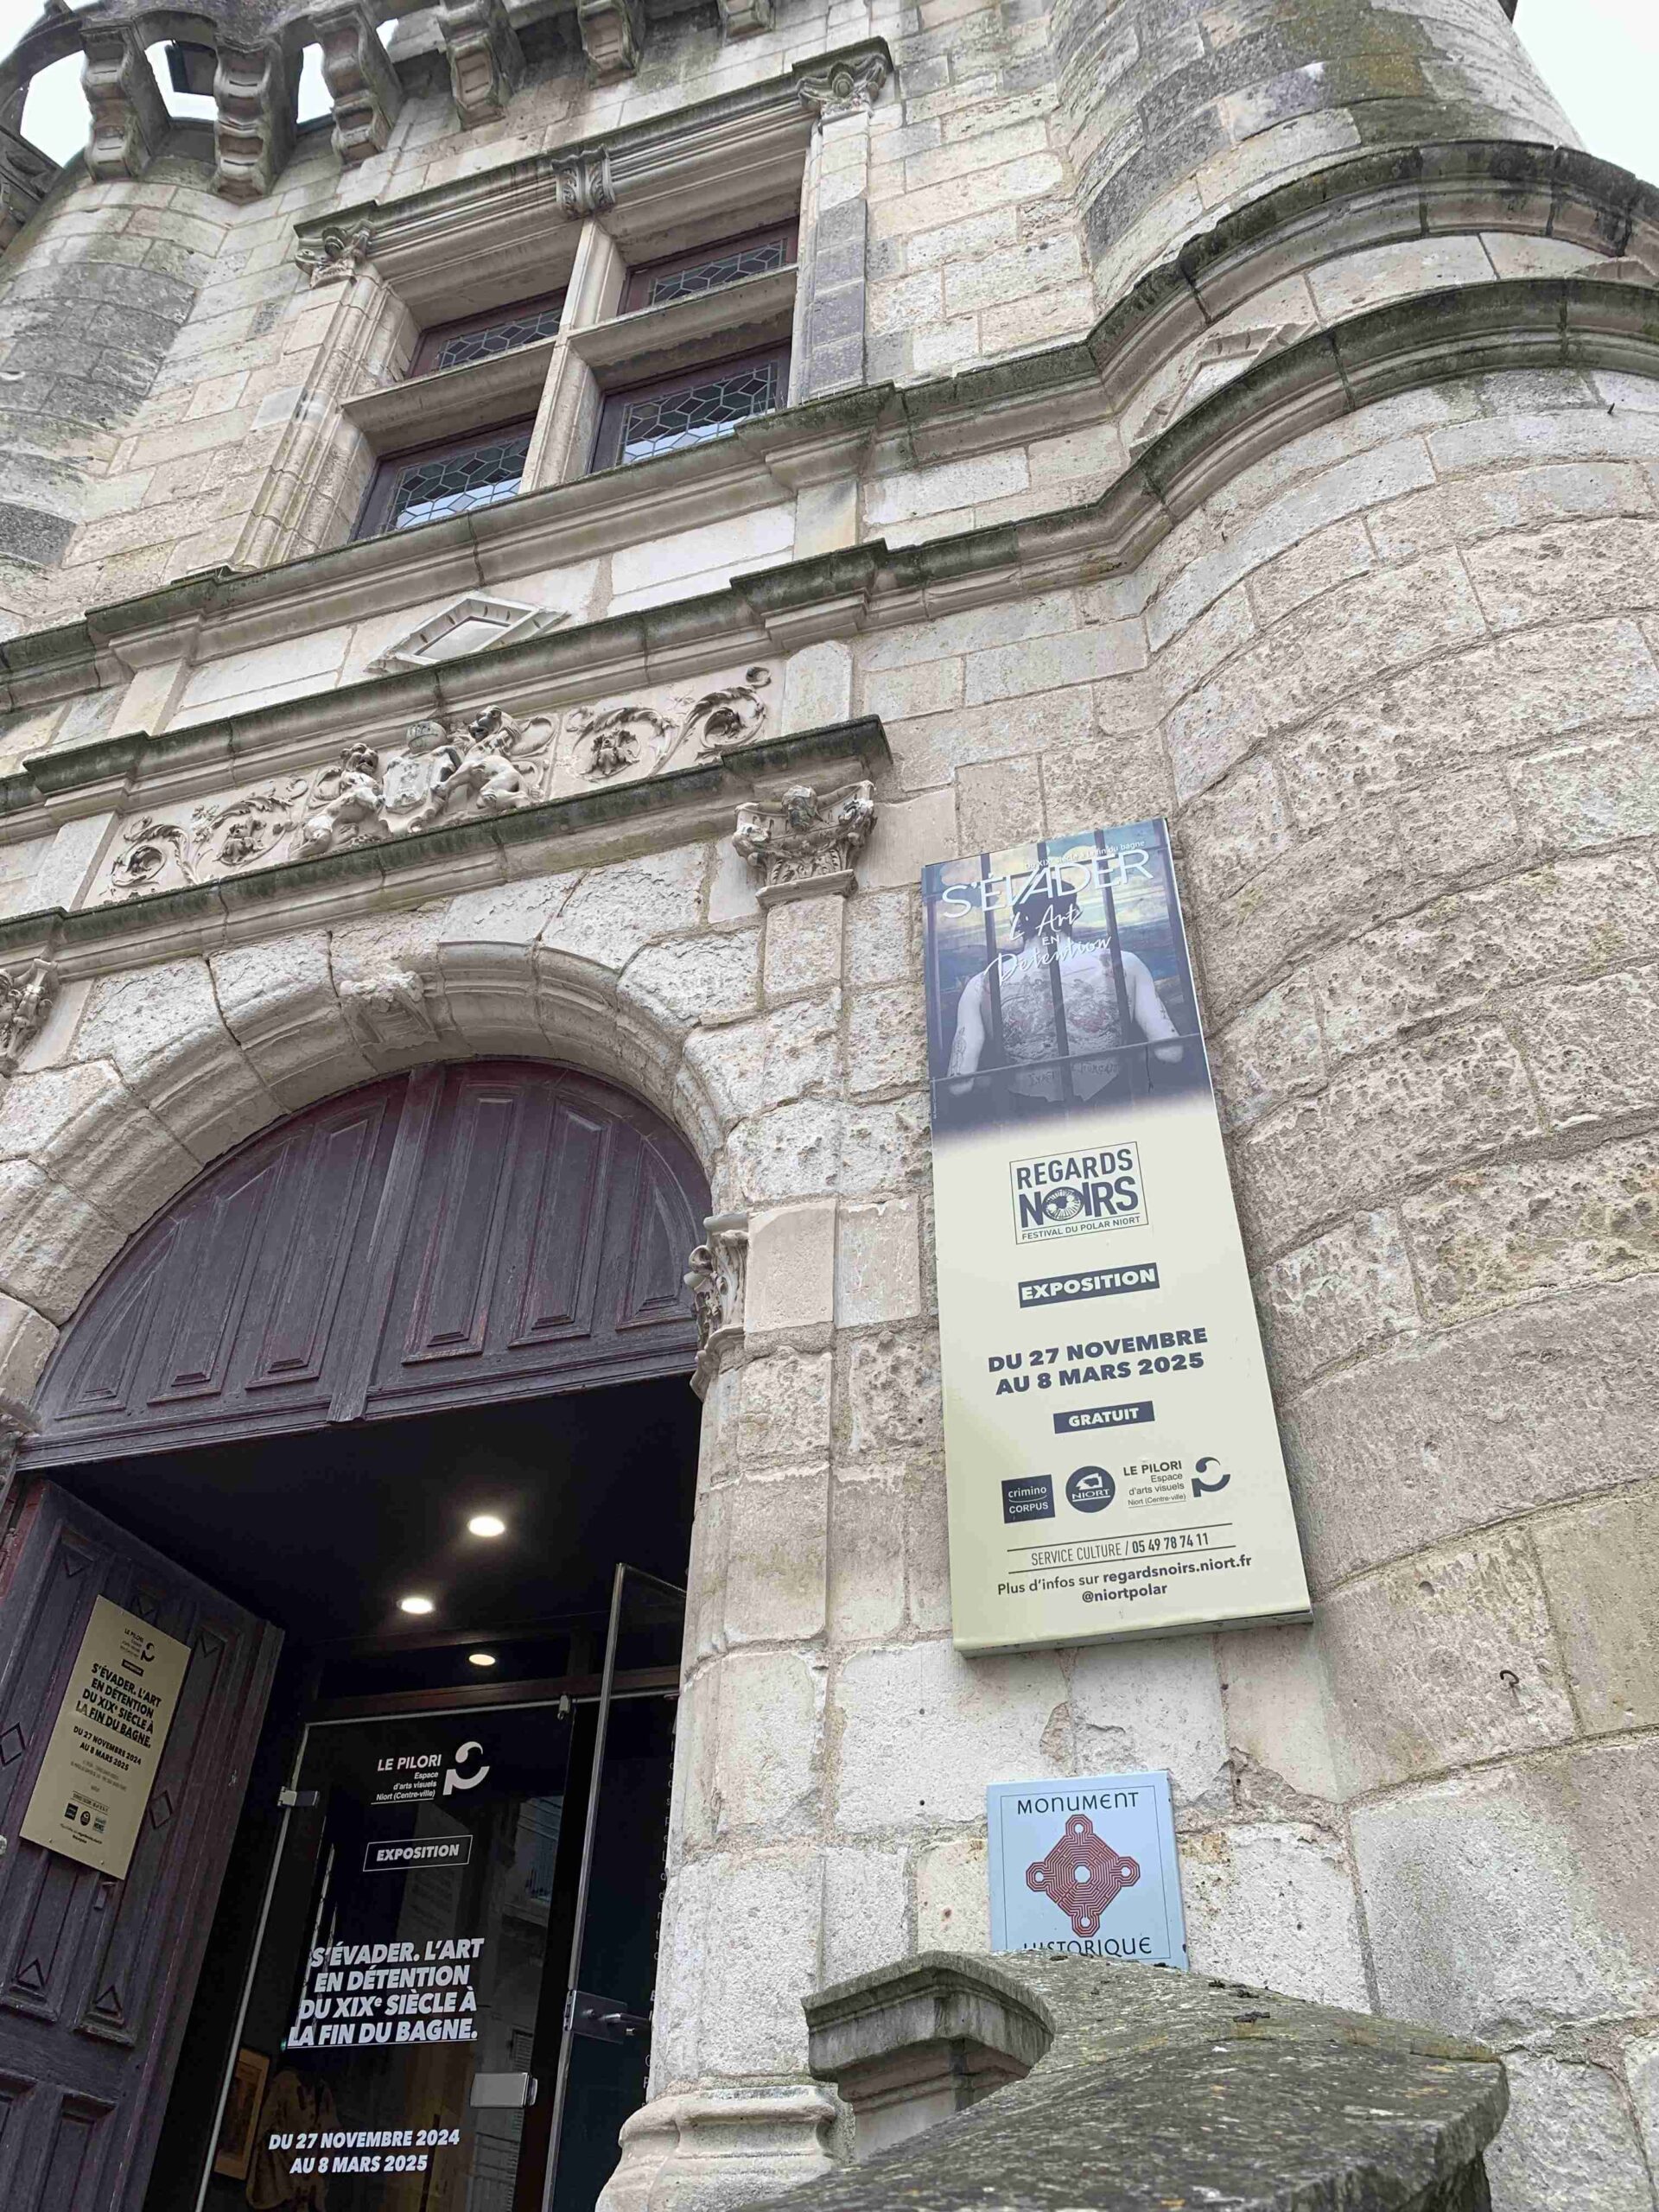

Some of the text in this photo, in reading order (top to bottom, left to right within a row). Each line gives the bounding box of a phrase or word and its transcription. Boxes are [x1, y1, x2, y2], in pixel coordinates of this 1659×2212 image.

[1120, 840, 1145, 851] bagne
[942, 849, 1154, 918] S'ÉVADER
[1042, 935, 1059, 946] EN
[1016, 1148, 1134, 1190] REGARDS
[1022, 1216, 1141, 1240] FESTIVAL DU POLAR NIORT
[1021, 1267, 1157, 1301] EXPOSITION
[988, 1327, 1208, 1372] DU 27 NOVEMBRE
[995, 1352, 1205, 1395] AU 8 MARS 2025
[1068, 1407, 1140, 1427] GRATUIT
[1123, 1460, 1182, 1476] LE PILORI
[1151, 1473, 1183, 1484] Espace
[1007, 1485, 1047, 1498] crimino
[1071, 1489, 1110, 1500] NIORT
[1128, 1483, 1185, 1496] d'arts visuels
[1128, 1493, 1186, 1506] Niort (Centre-ville)
[1009, 1502, 1049, 1514] CORPUS
[1031, 1533, 1209, 1566] SERVICE CULTURE / 05 49 78 74 11
[997, 1554, 1252, 1595] Plus d'infos sur regardsnoirs.niort.fr
[1082, 1583, 1167, 1603] @niortpolar
[82, 1688, 98, 1703] DU
[91, 1678, 154, 1719] EN DÉTENTION
[138, 1688, 162, 1707] L'ART
[76, 1700, 87, 1716] LA
[89, 1707, 105, 1725] FIN
[105, 1715, 120, 1731] DU
[73, 1726, 142, 1765] DU 27 NOVEMBRE 2024
[79, 1742, 90, 1752] AU
[95, 1748, 113, 1764] MARS
[113, 1758, 130, 1771] 2025
[377, 1754, 442, 1771] LE PILORI
[413, 1780, 437, 1789] visuels
[414, 1771, 439, 1781] Espace
[393, 1789, 435, 1800] (Centre-ville)
[1017, 1791, 1140, 1815] MONUMENT
[376, 1844, 460, 1862] EXPOSITION
[310, 1937, 486, 1967] S'ÉVADER. L'ART
[314, 1964, 470, 1993] EN DÉTENTION
[300, 1998, 332, 2020] DU
[385, 1988, 457, 2016] SIÈCLE
[459, 1986, 477, 2012] À
[287, 2018, 478, 2047] LA FIN DU BAGNE.
[268, 2129, 461, 2151] DU 27 NOVEMBRE 2024
[289, 2154, 429, 2174] AU 8 MARS 2025
